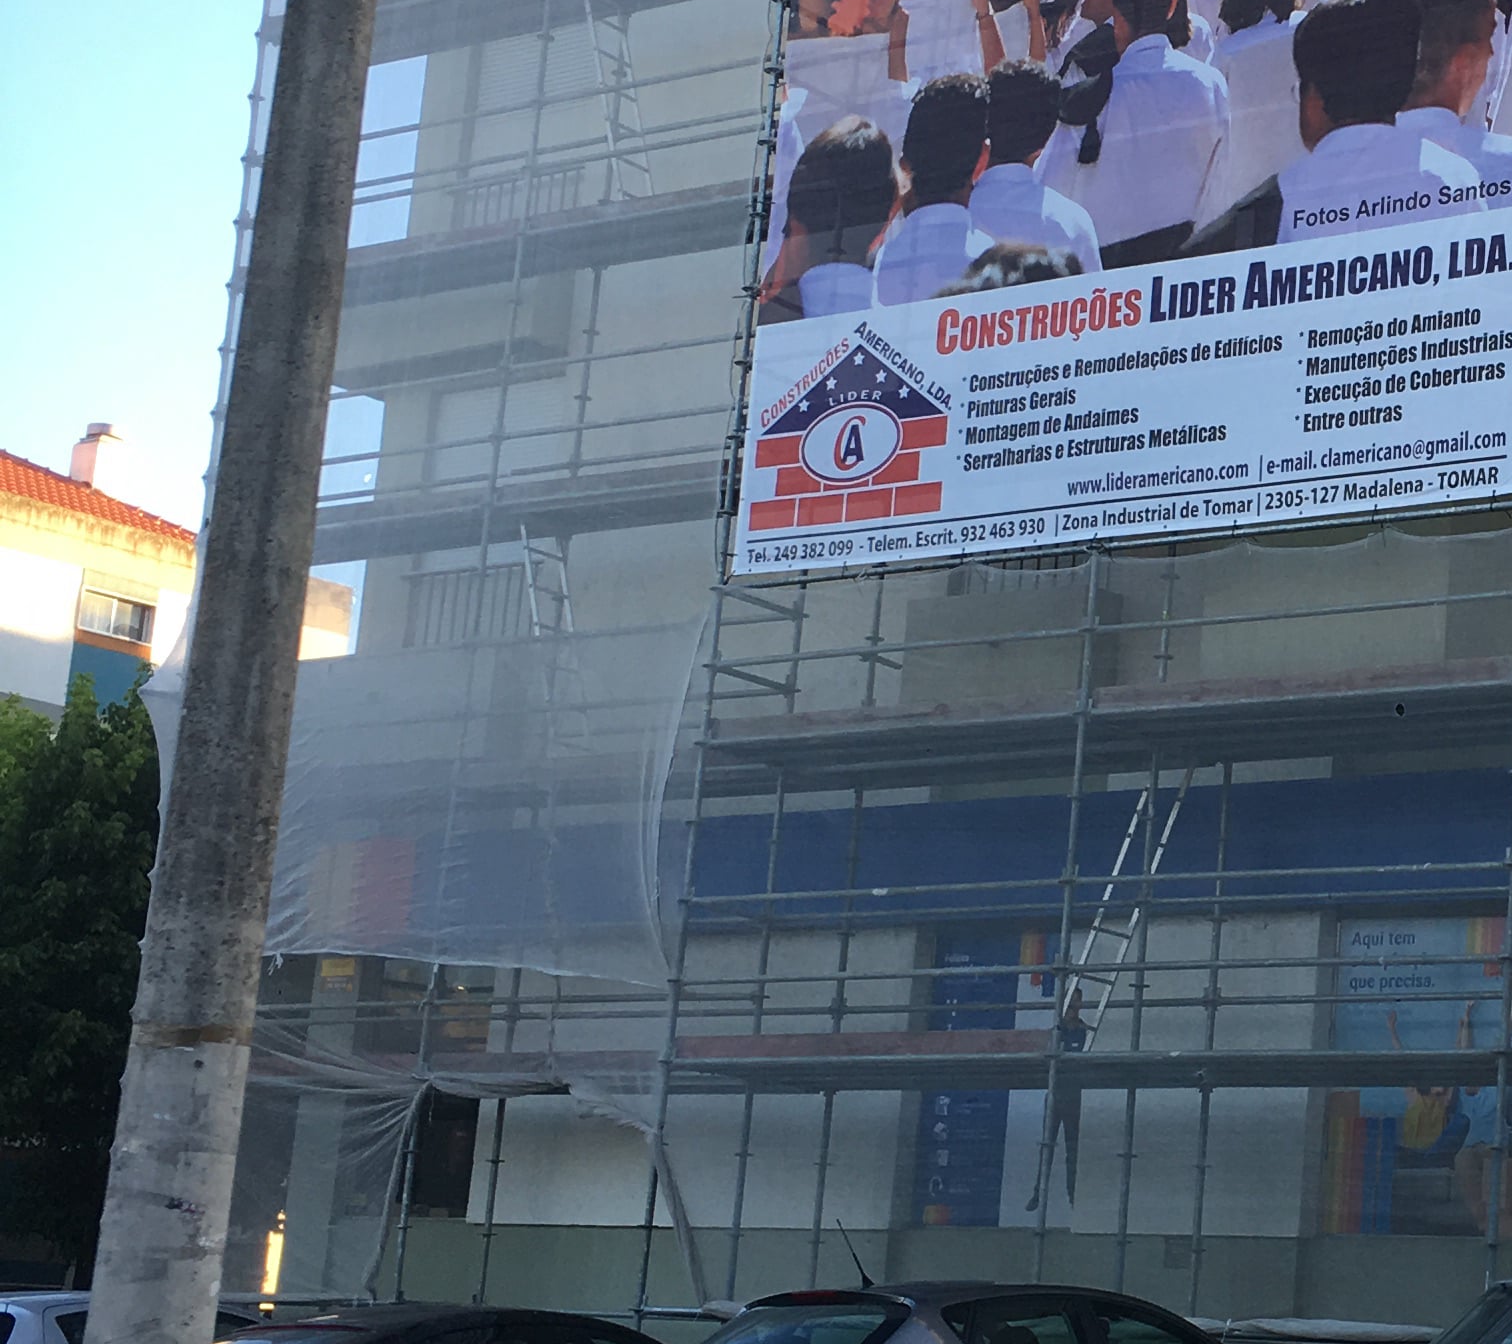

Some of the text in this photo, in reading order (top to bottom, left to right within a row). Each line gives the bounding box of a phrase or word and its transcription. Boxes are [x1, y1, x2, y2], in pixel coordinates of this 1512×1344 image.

[1293, 180, 1512, 229] Fotos Arlindo Santos
[1150, 276, 1236, 323] LIDER
[1307, 307, 1481, 348] Remoção do Amianto
[854, 321, 953, 411] AMERICANO, LDA.
[968, 334, 1283, 393] Construções e Remodelações de Edifícios
[1306, 345, 1418, 377] Manutenções
[828, 389, 883, 407] LIDER
[966, 388, 1077, 419] Pinturas Gerais
[1304, 361, 1506, 404] Execução de Coberturas
[965, 407, 1140, 446] Montagem de Andaimes
[1303, 404, 1403, 433] Entre outras
[963, 423, 1227, 472] Serralharias e Estruturas Metálicas
[1067, 431, 1507, 496] www.lideramericano.com e-mail. clamericano@gmail.com
[746, 547, 771, 564] Tel.
[774, 544, 798, 561] 249
[800, 541, 826, 560] 382
[828, 539, 854, 557] 099
[867, 534, 913, 553] Telem.
[915, 528, 958, 548] Escrit.
[960, 524, 987, 543] 932
[988, 520, 1016, 540] 463
[1018, 517, 1046, 537] 930
[1061, 513, 1099, 531] Zona
[1102, 502, 1176, 527] Industrial
[1180, 501, 1200, 519] de
[1203, 496, 1254, 517] Tomar
[1265, 485, 1340, 510] 2305-127
[1343, 477, 1424, 502] Madalena
[1438, 466, 1500, 490] TOMAR
[1351, 931, 1416, 949] Aqui tem
[1350, 973, 1435, 992] que precisa.
